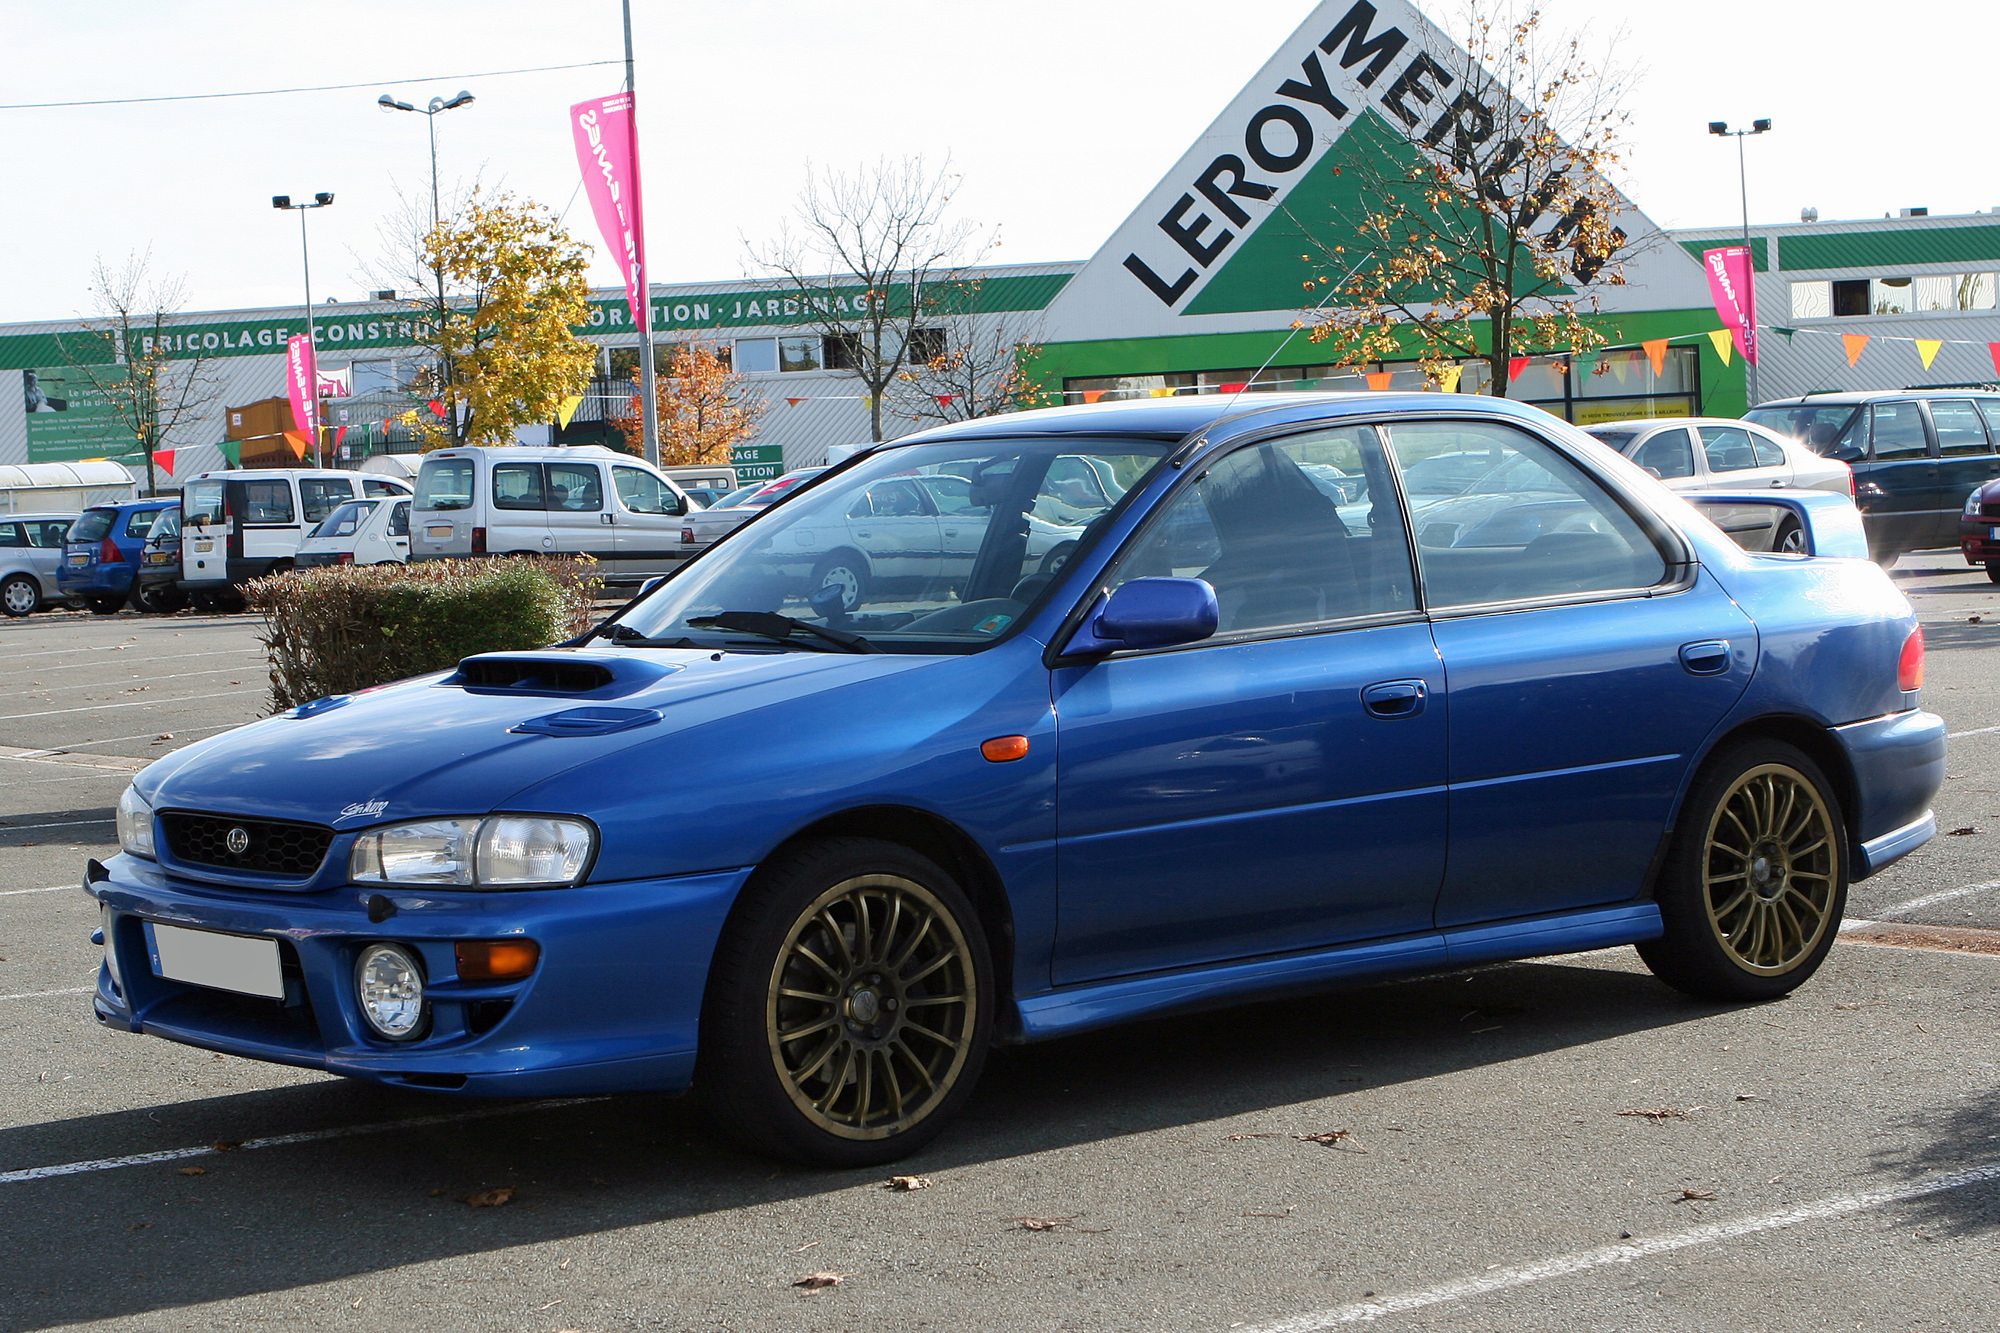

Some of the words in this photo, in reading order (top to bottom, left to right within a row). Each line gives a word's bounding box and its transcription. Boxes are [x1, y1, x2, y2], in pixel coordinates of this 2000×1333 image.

[1122, 50, 1349, 308] LEROY
[142, 328, 289, 354] BRICOLAGE
[68, 389, 79, 397] Le
[727, 449, 759, 460] LAGE
[736, 466, 775, 478] CTION
